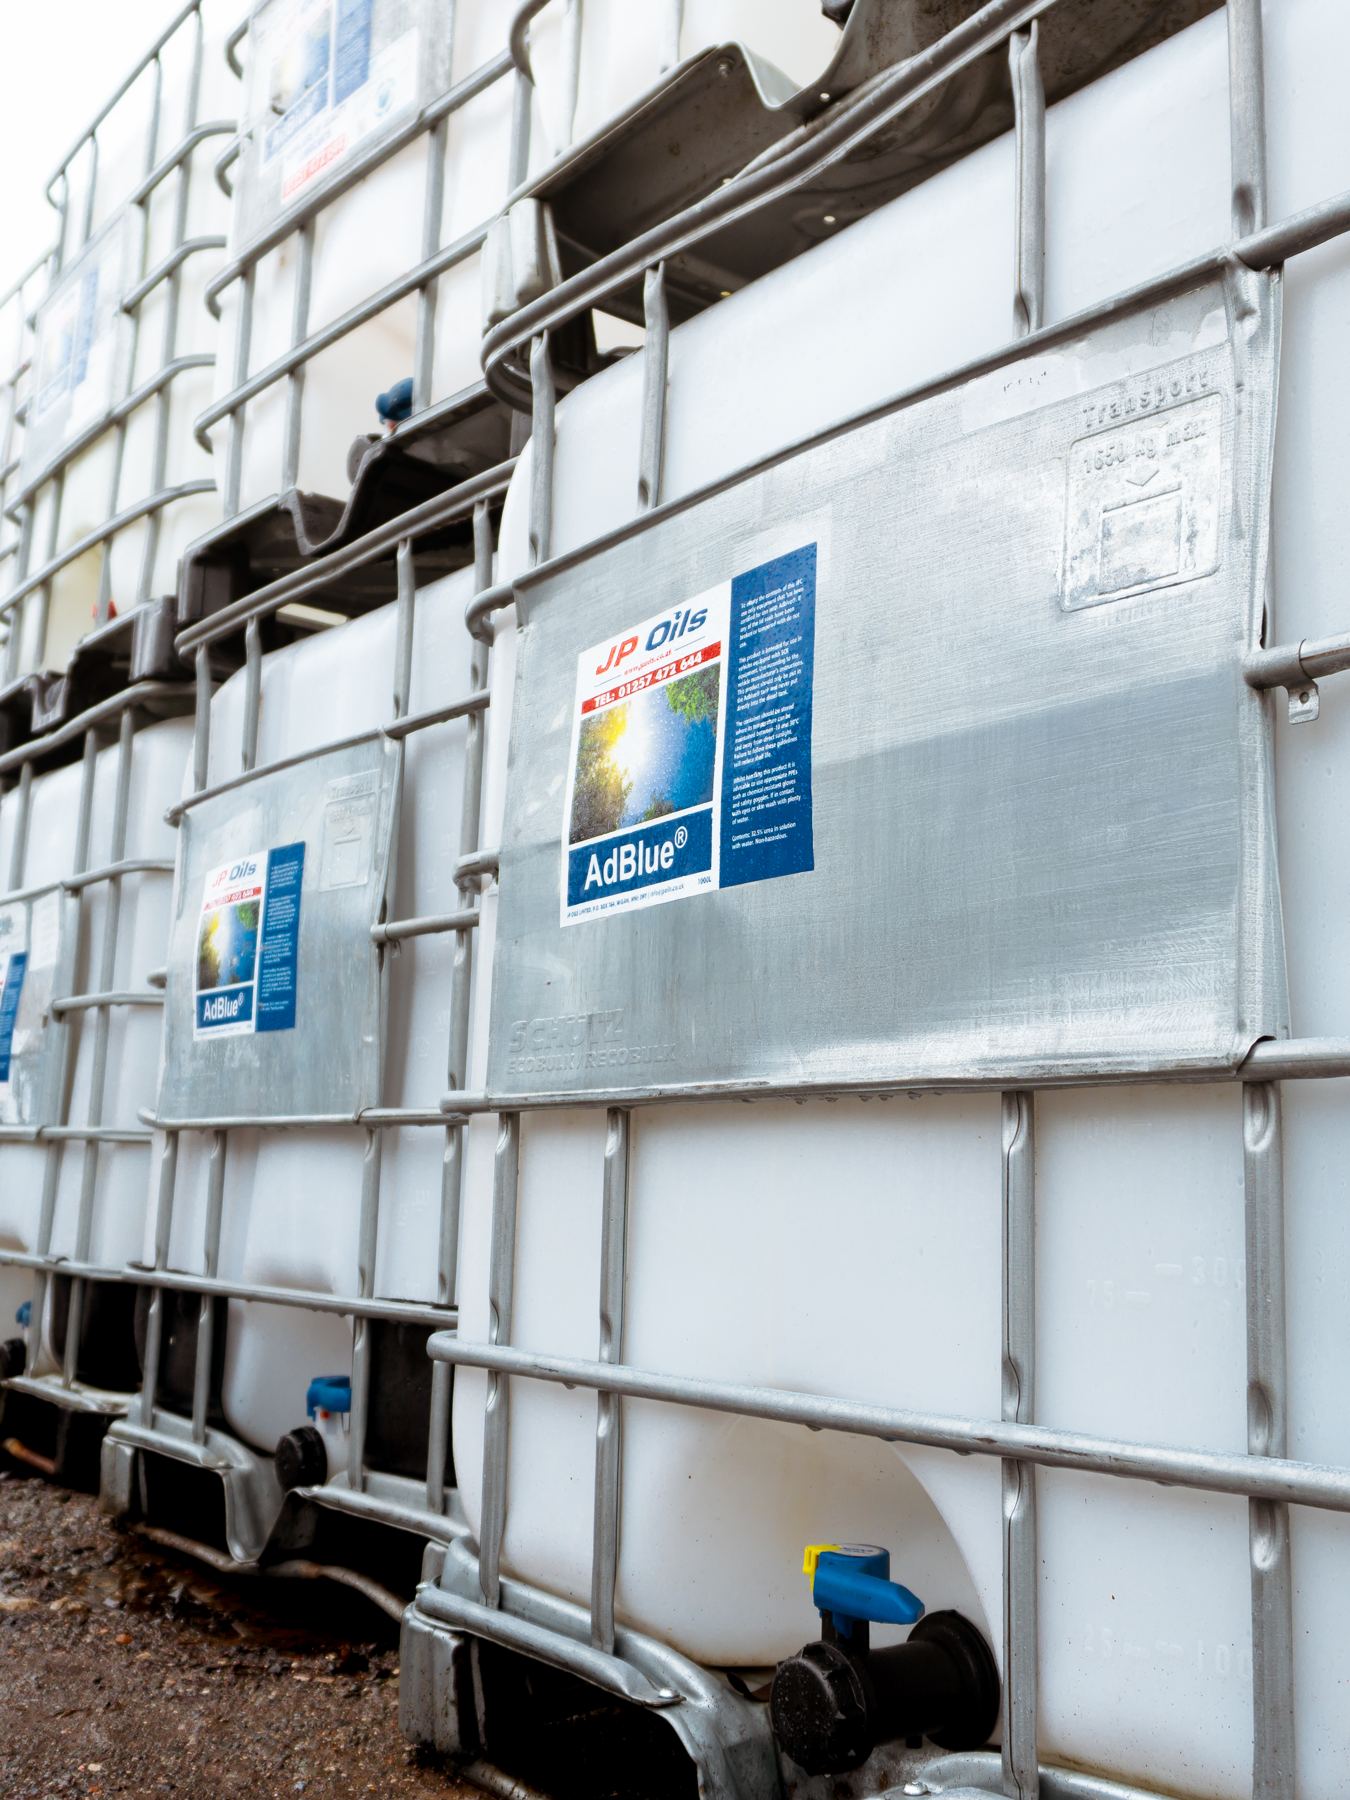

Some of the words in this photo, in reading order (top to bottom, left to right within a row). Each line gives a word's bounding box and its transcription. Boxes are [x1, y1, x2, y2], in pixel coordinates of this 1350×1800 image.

[596, 636, 638, 676] JP
[645, 608, 708, 651] Oils
[594, 693, 616, 708] TEL:
[618, 671, 652, 698] 01257
[655, 664, 677, 680] 472
[680, 651, 703, 671] 644
[732, 781, 750, 791] advisable
[763, 772, 787, 784] appropriate
[733, 775, 745, 783] Whilst
[745, 770, 762, 780] handling
[771, 763, 787, 774] product
[740, 798, 752, 806] safety
[752, 794, 769, 804] goggles.
[779, 787, 794, 796] contact
[746, 786, 763, 796] chemical
[763, 782, 781, 791] resistant
[782, 778, 795, 788] gloves
[787, 794, 800, 803] plenty
[731, 832, 750, 841] Contents:
[778, 821, 795, 830] solution
[754, 832, 787, 844] Non-hazardous.
[584, 826, 688, 890] AdBlue®
[212, 868, 228, 888] JP
[229, 860, 257, 882] Oils
[204, 992, 244, 1021] AdBlue®
